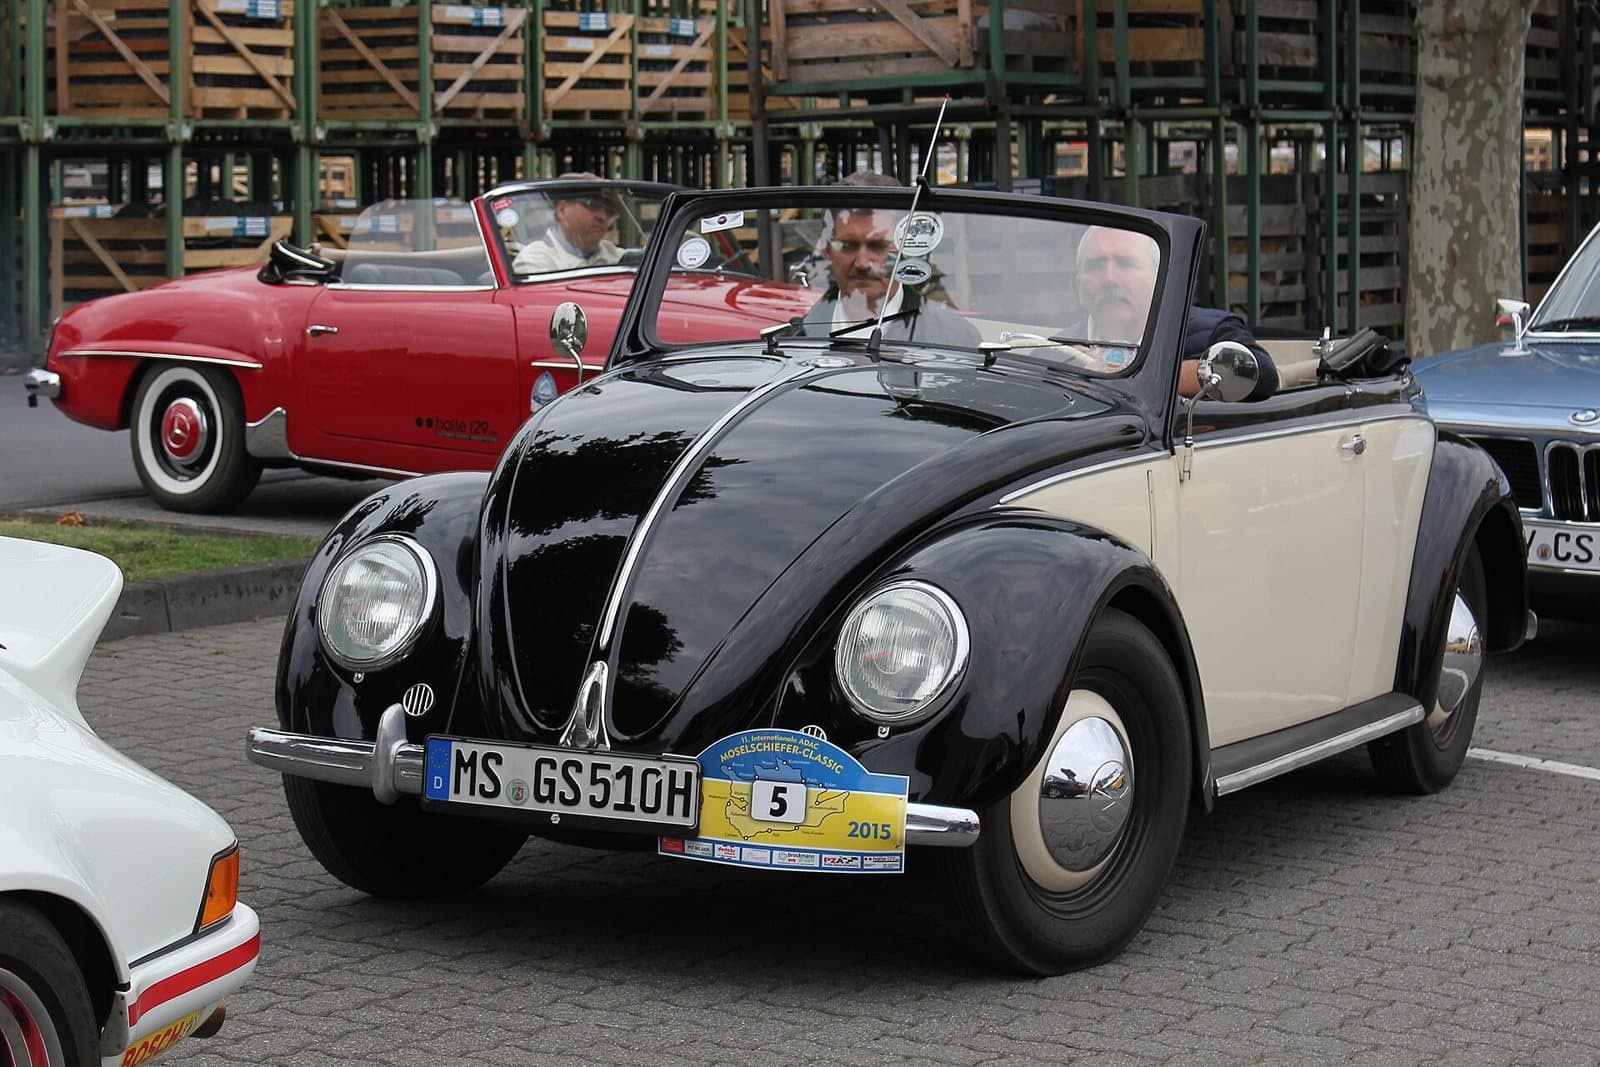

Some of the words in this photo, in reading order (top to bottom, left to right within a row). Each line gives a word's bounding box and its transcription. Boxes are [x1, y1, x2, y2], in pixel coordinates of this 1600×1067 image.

[470, 420, 489, 434] 129
[751, 734, 797, 744] Internationale
[798, 738, 820, 750] ADAC
[720, 742, 844, 774] MOSELSCHIEFER-CLASSIC
[433, 776, 443, 789] D
[453, 749, 504, 798] MS
[769, 786, 788, 817] 5
[847, 821, 892, 840] 2015
[120, 1020, 187, 1067] BOSCH
